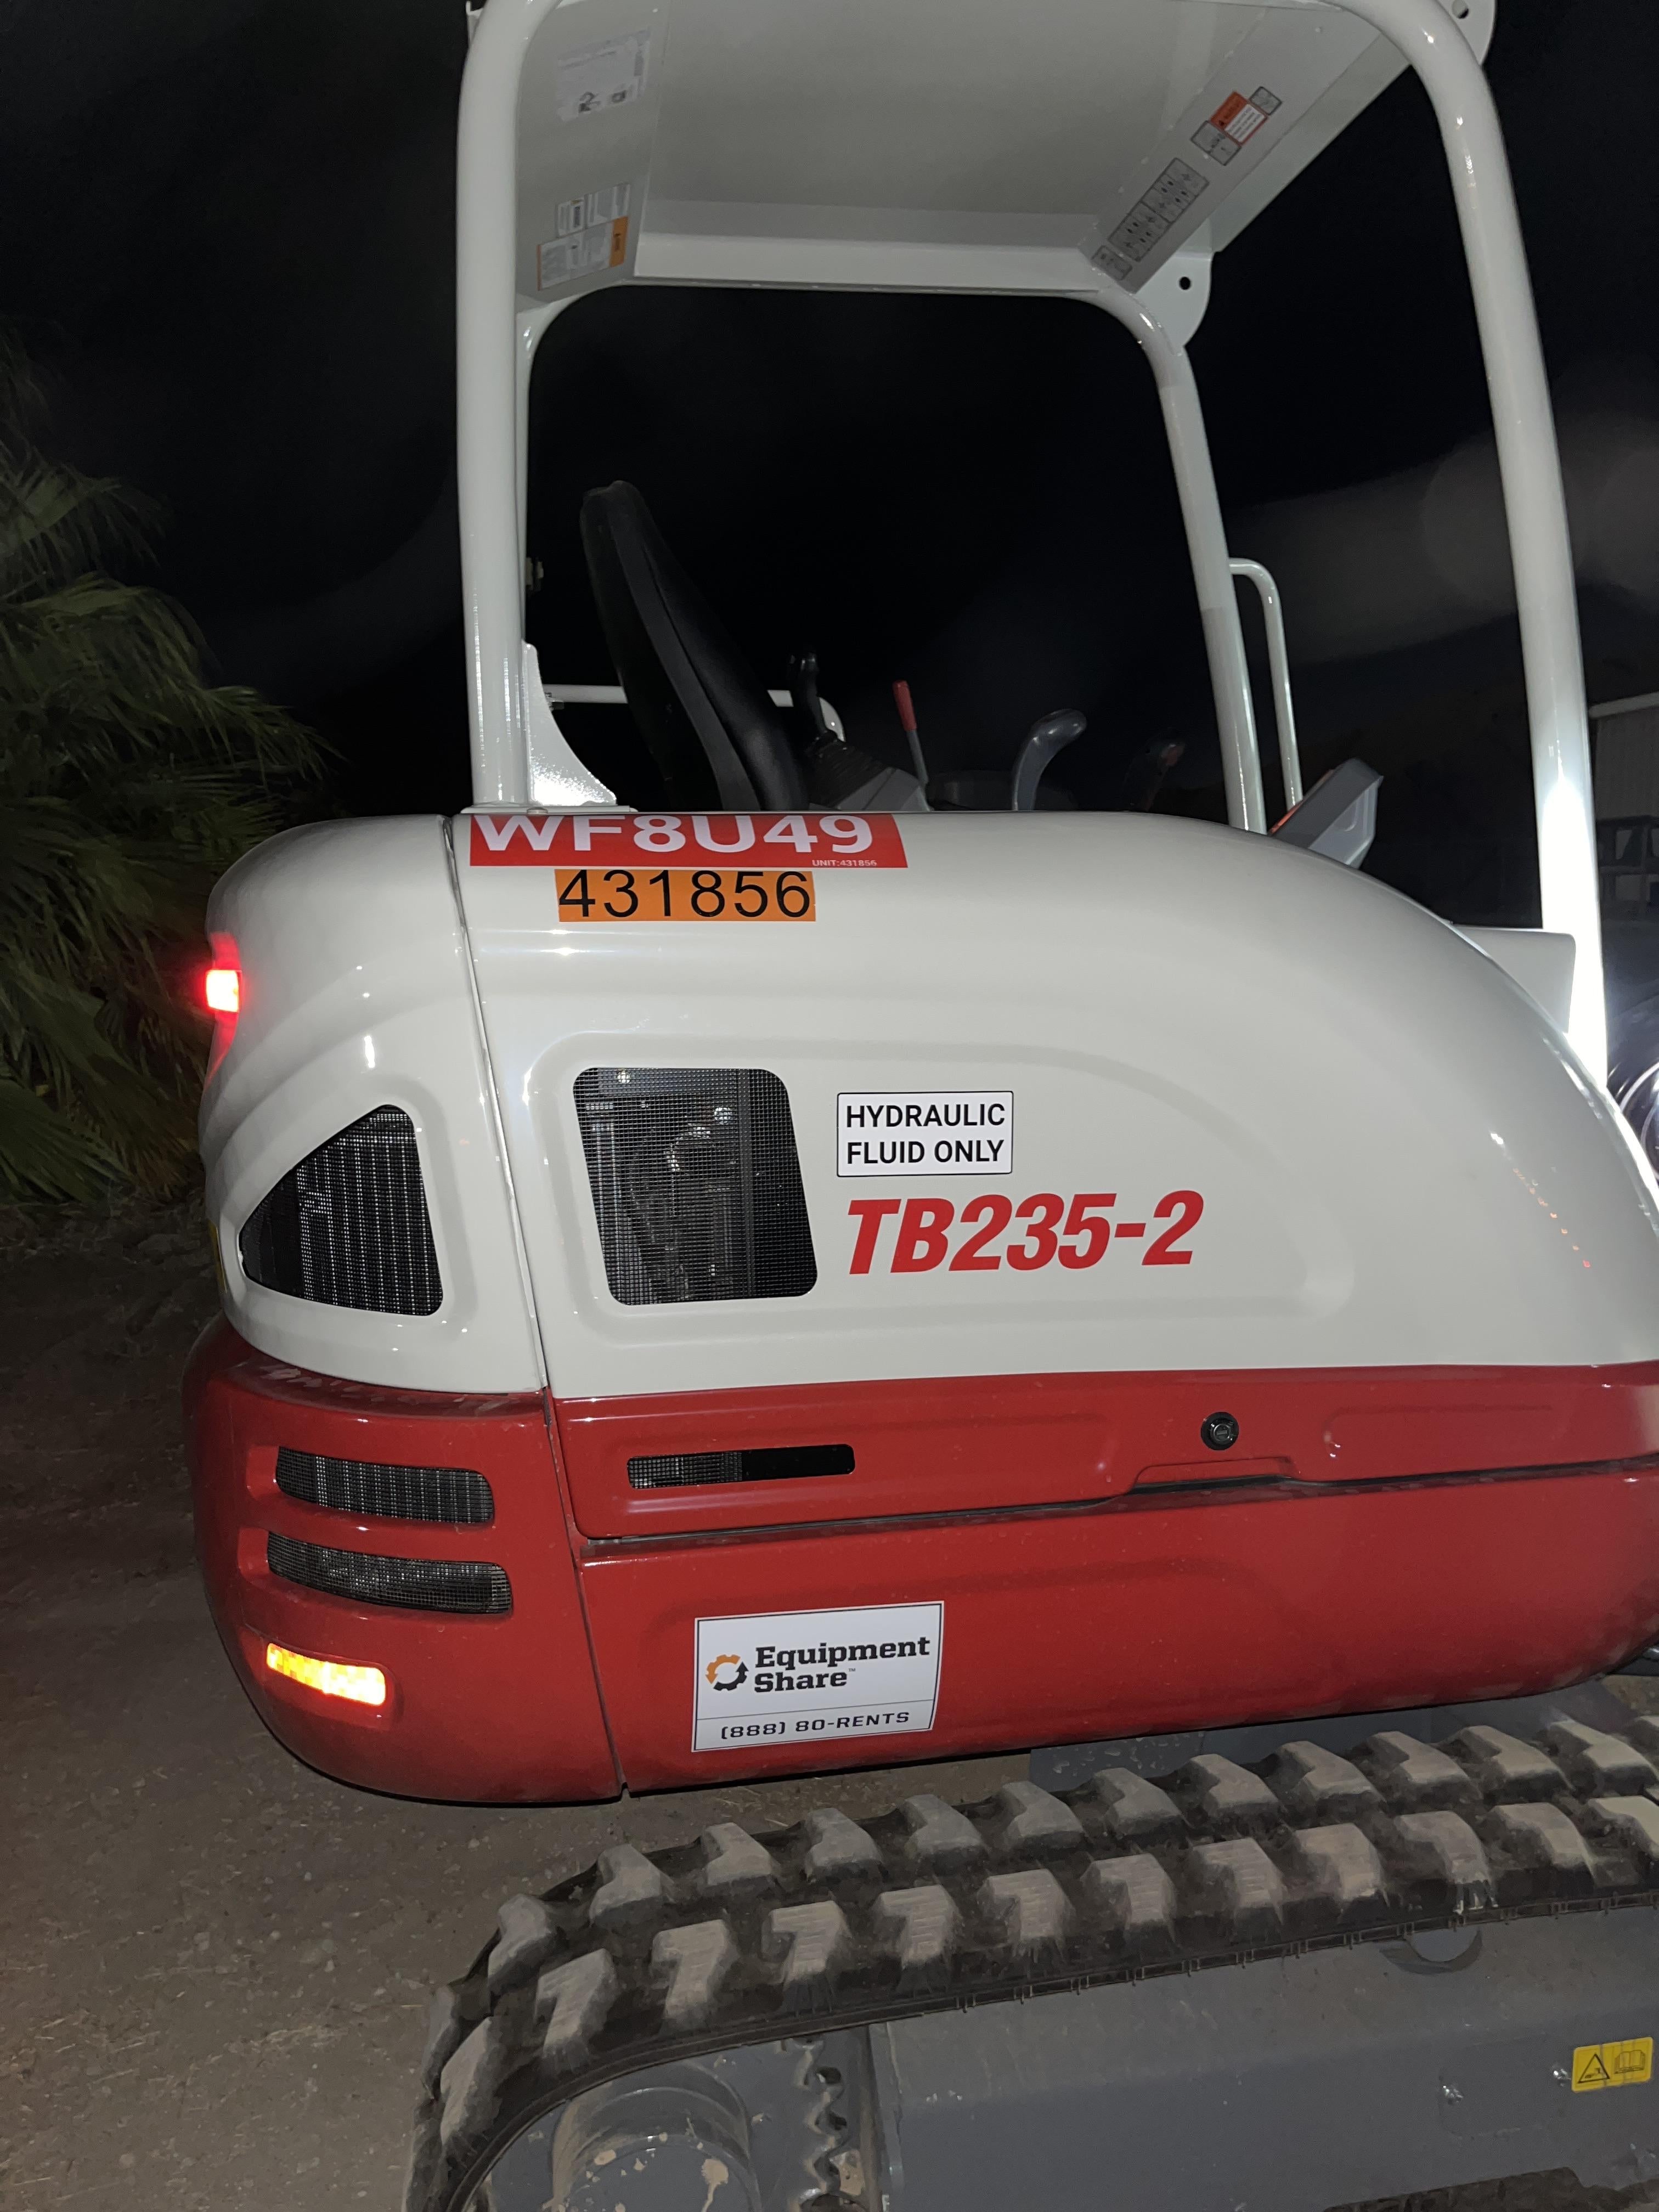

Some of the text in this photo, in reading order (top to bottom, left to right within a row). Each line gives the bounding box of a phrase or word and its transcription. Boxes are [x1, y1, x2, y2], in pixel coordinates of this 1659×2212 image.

[473, 815, 873, 853] WF8U49
[559, 870, 810, 917] 431856
[846, 1103, 1006, 1128] HYDRAULIC
[847, 1139, 1005, 1165] FLUID ONLY
[847, 1190, 1205, 1276] TB235-2
[755, 1637, 931, 1671] Equipment
[754, 1671, 848, 1693] Share
[721, 1711, 910, 1740] (888) 80-RENTS
